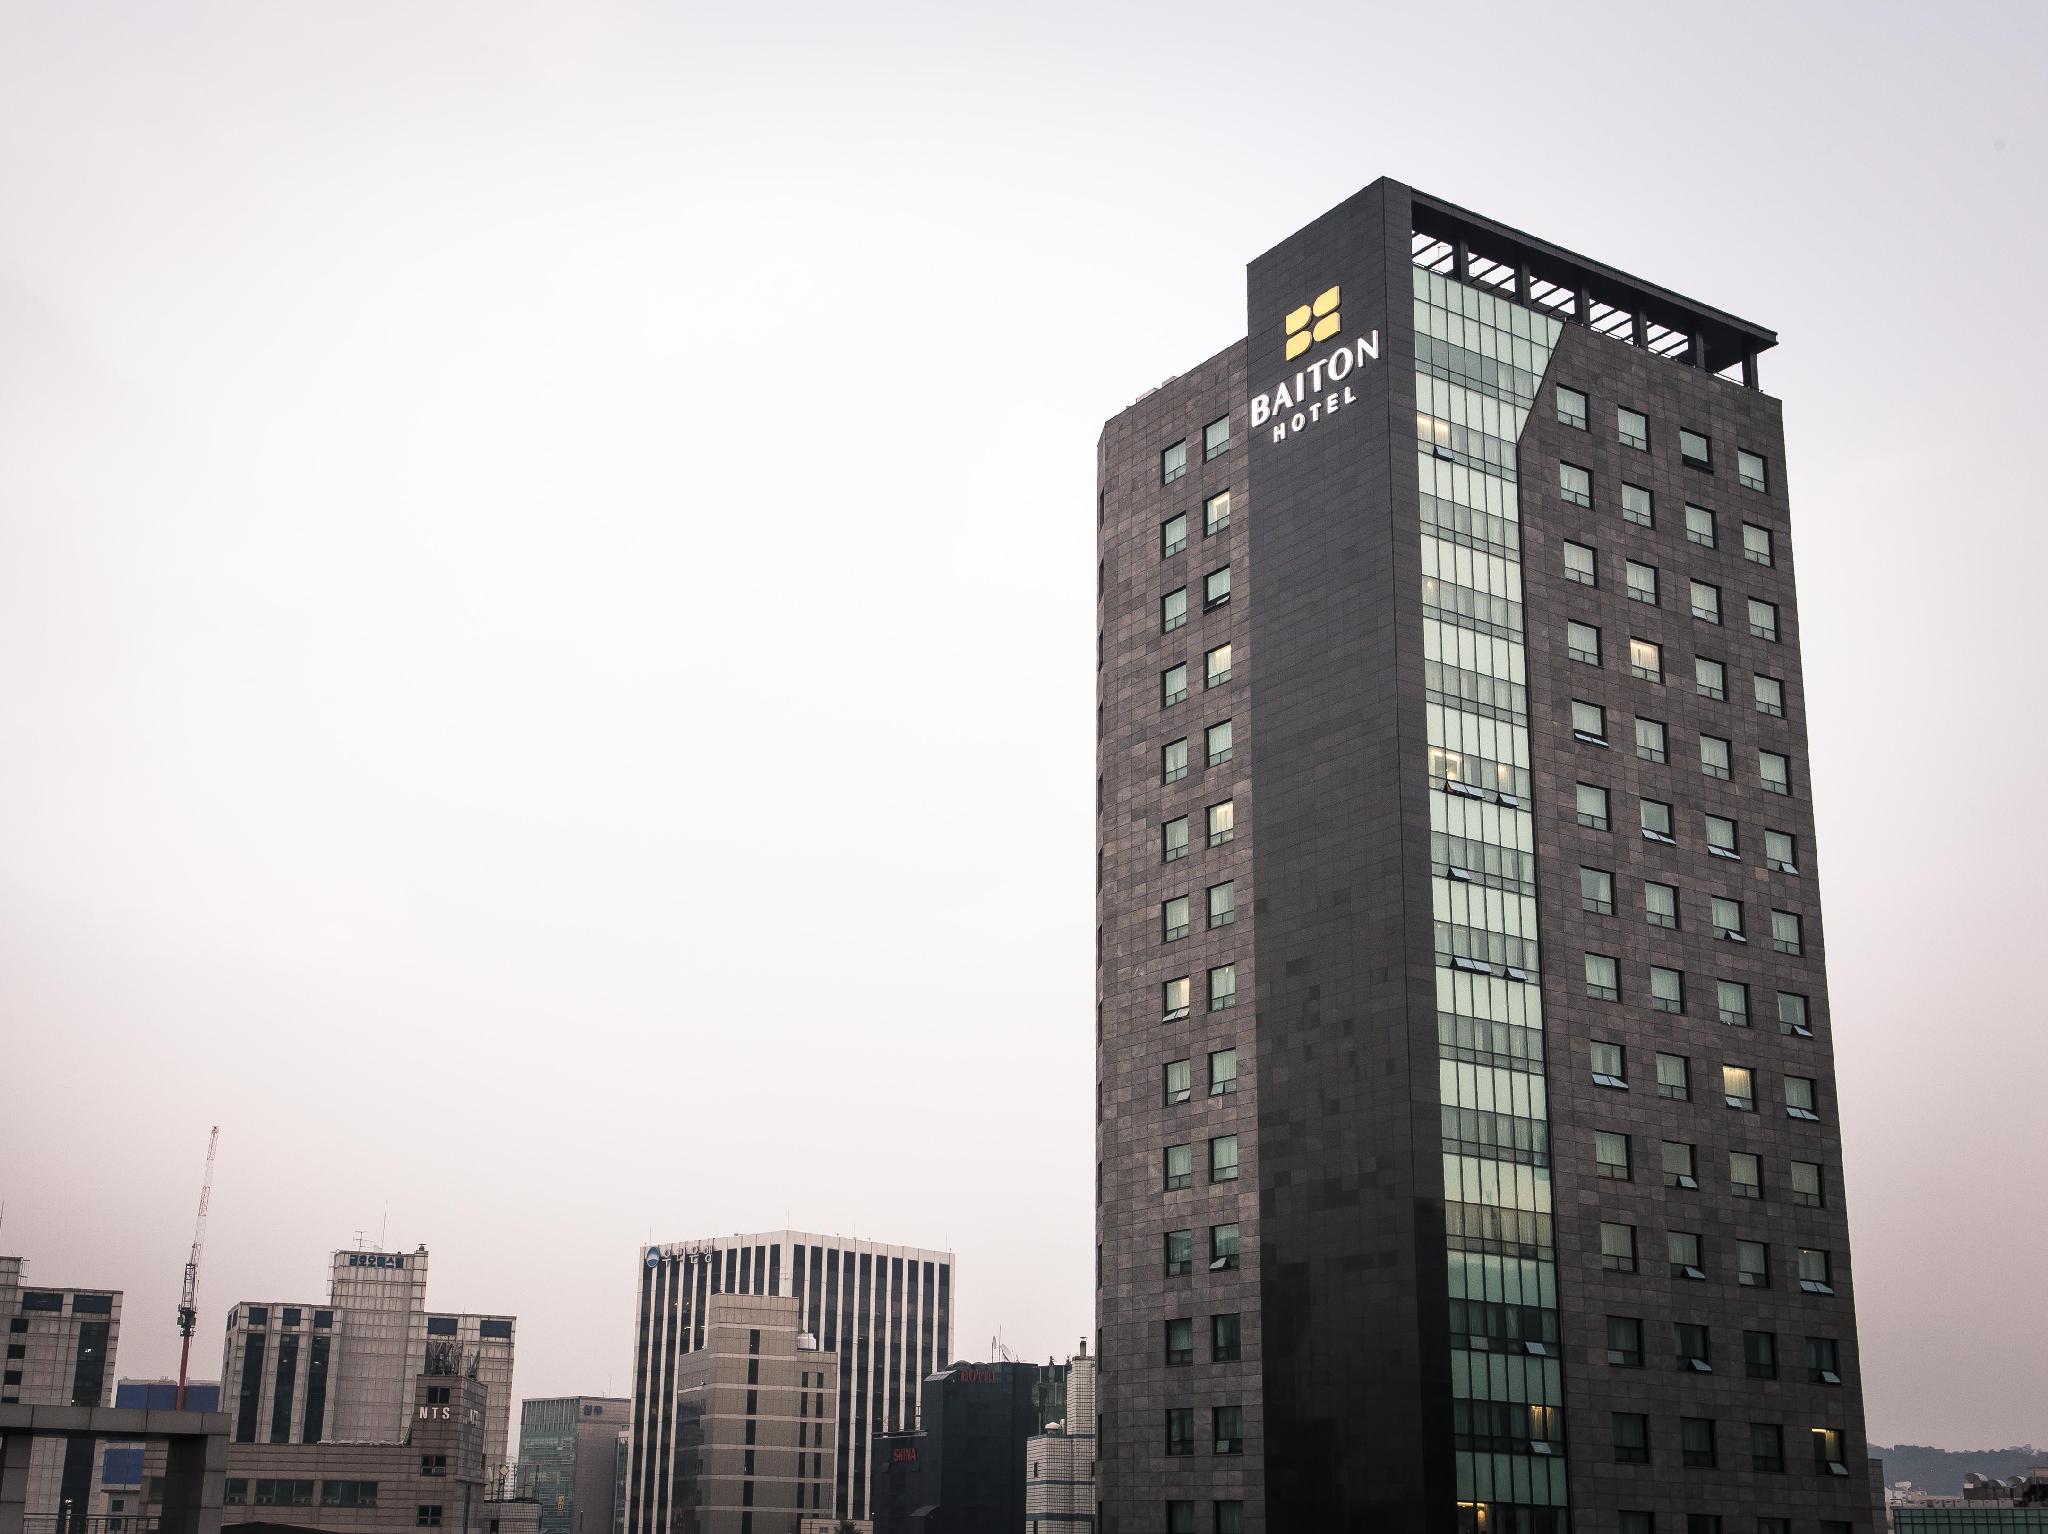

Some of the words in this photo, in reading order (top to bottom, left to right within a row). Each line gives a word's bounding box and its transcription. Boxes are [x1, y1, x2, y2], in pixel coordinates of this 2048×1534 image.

[1251, 329, 1379, 427] BAITON
[1273, 386, 1356, 443] HOTEL
[661, 1244, 713, 1267] 우리은행
[419, 1406, 450, 1420] NTS
